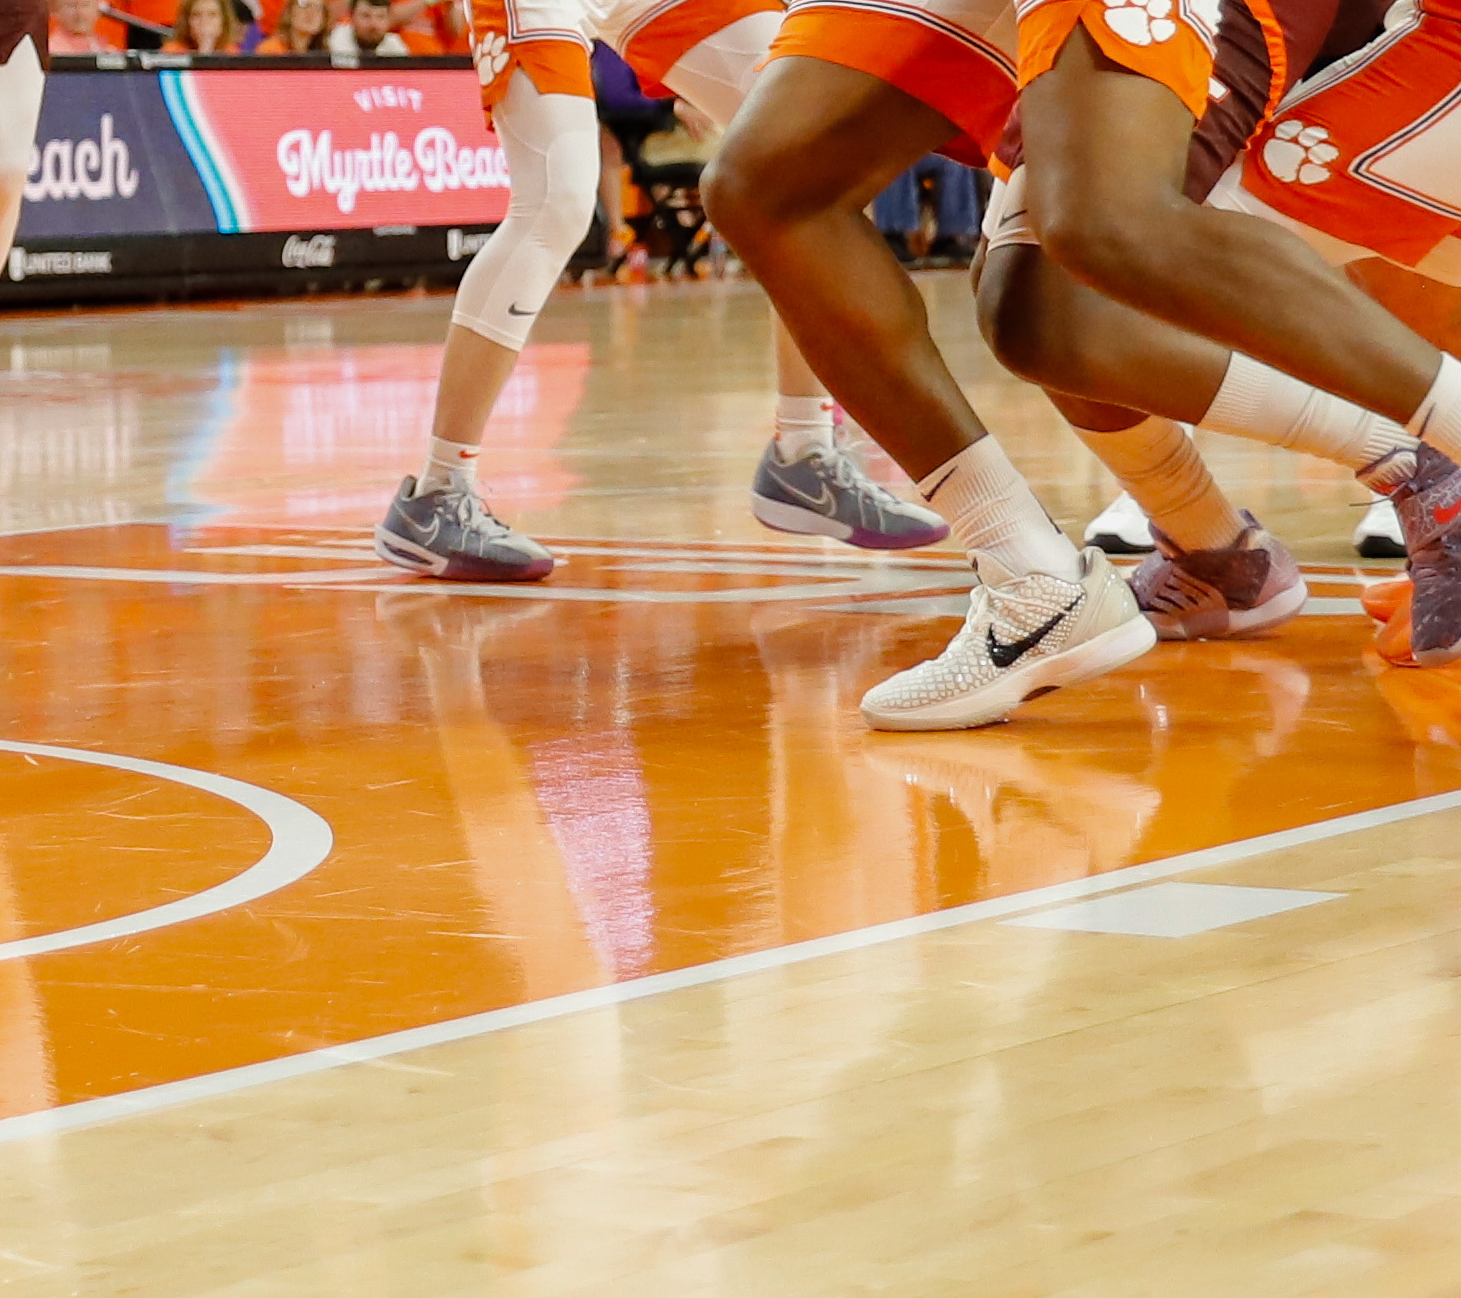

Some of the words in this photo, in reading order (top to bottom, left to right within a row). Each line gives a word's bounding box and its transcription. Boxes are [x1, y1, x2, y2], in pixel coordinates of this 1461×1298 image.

[353, 85, 423, 113] VISIT
[277, 128, 420, 214] Myrtle
[413, 125, 512, 193] Beac
